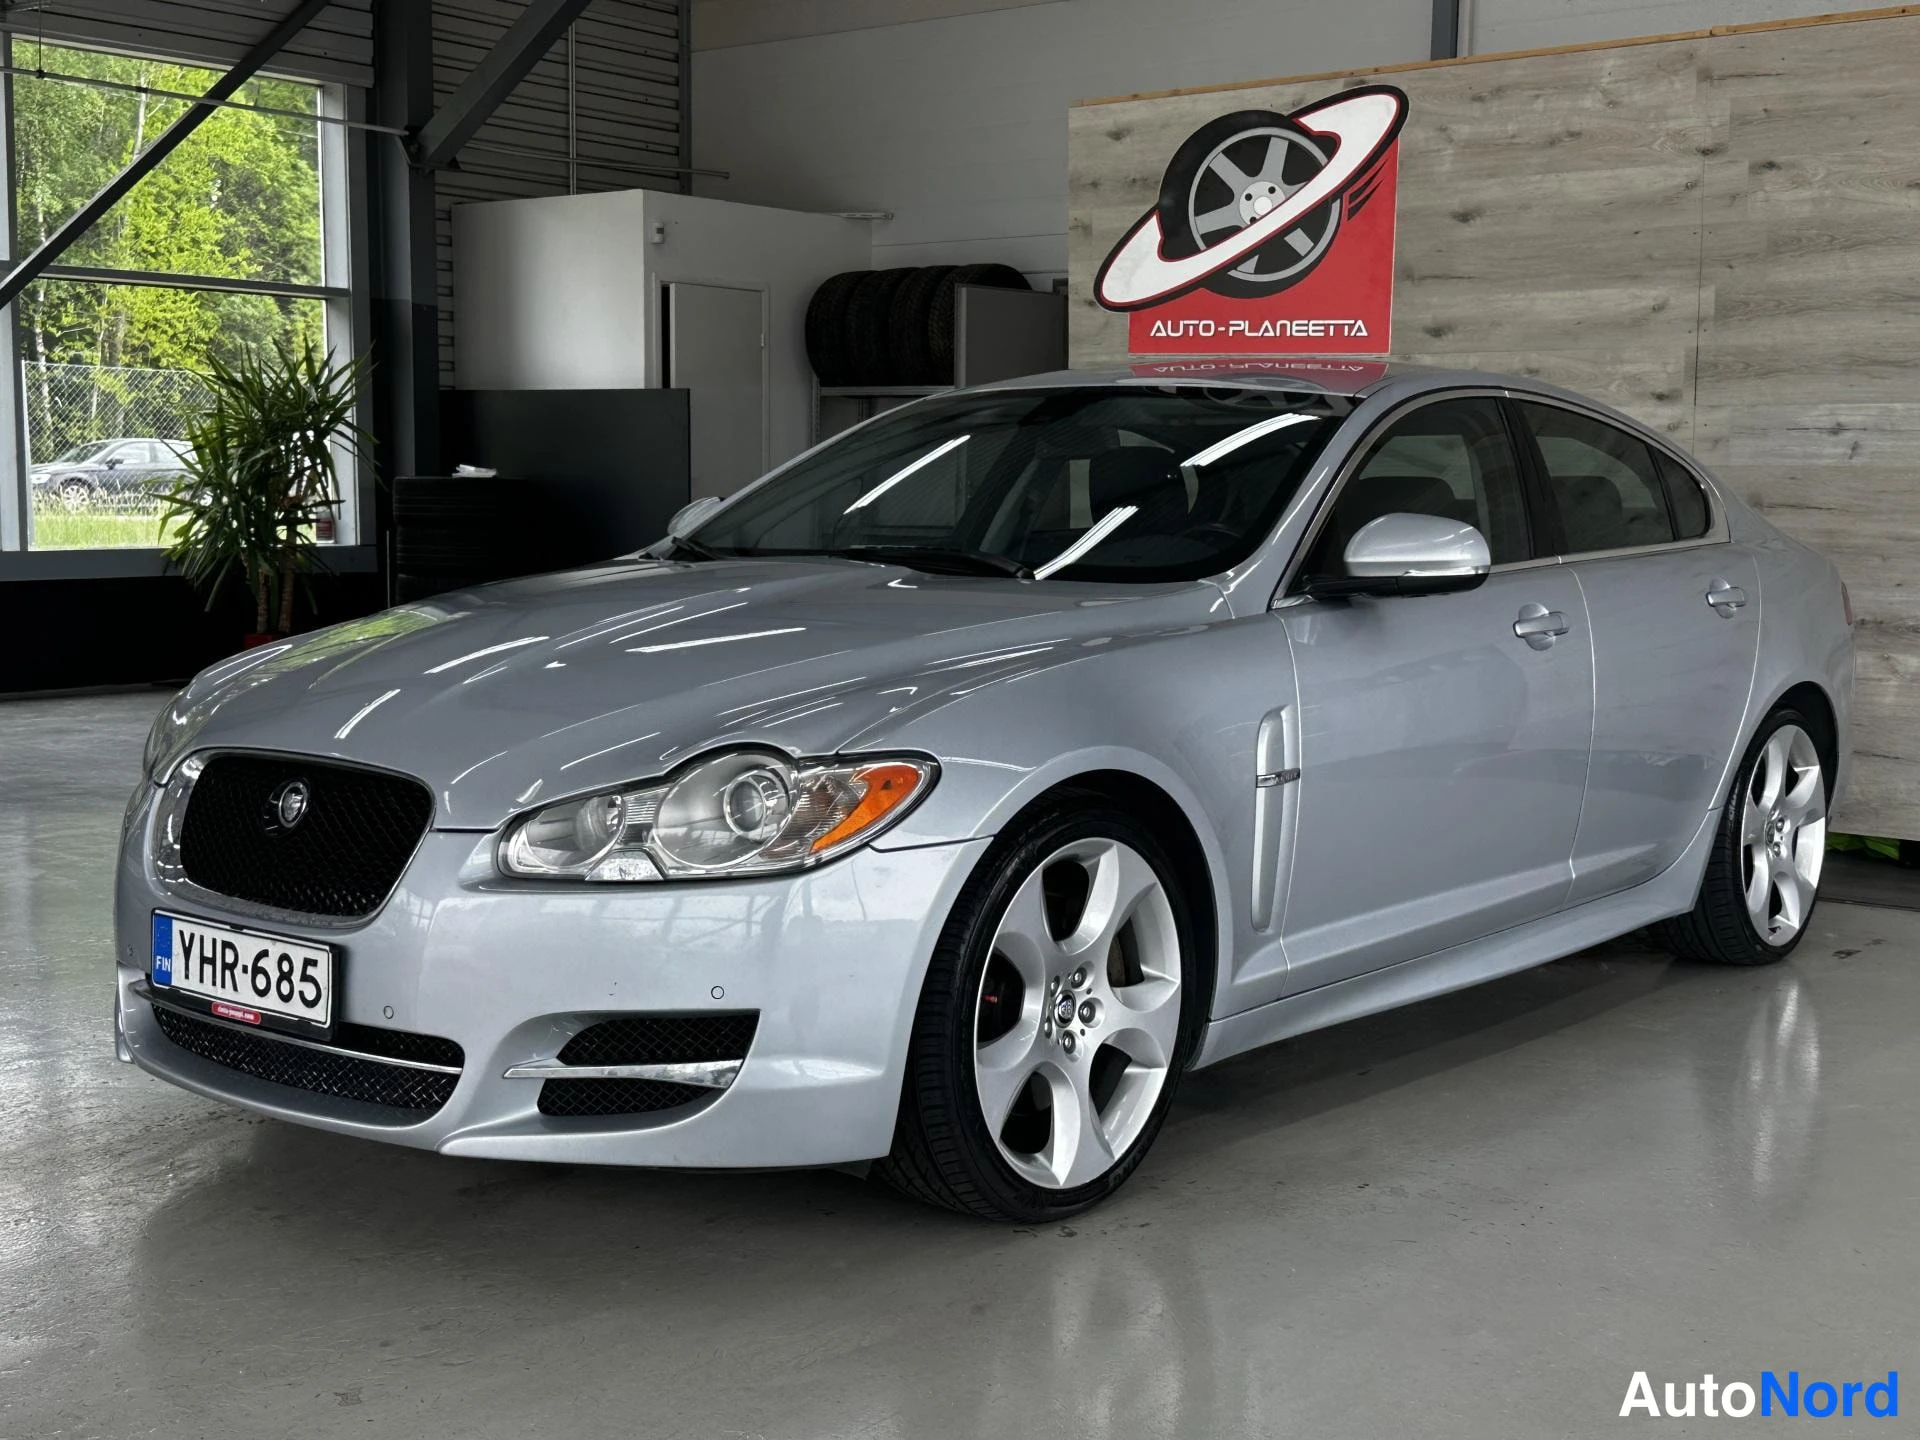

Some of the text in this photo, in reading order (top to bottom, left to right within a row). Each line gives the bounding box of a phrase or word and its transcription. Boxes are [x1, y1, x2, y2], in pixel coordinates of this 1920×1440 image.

[1150, 319, 1368, 337] AUTO-PLANEETTA
[155, 955, 172, 973] FIN
[179, 929, 322, 1009] YHR-685
